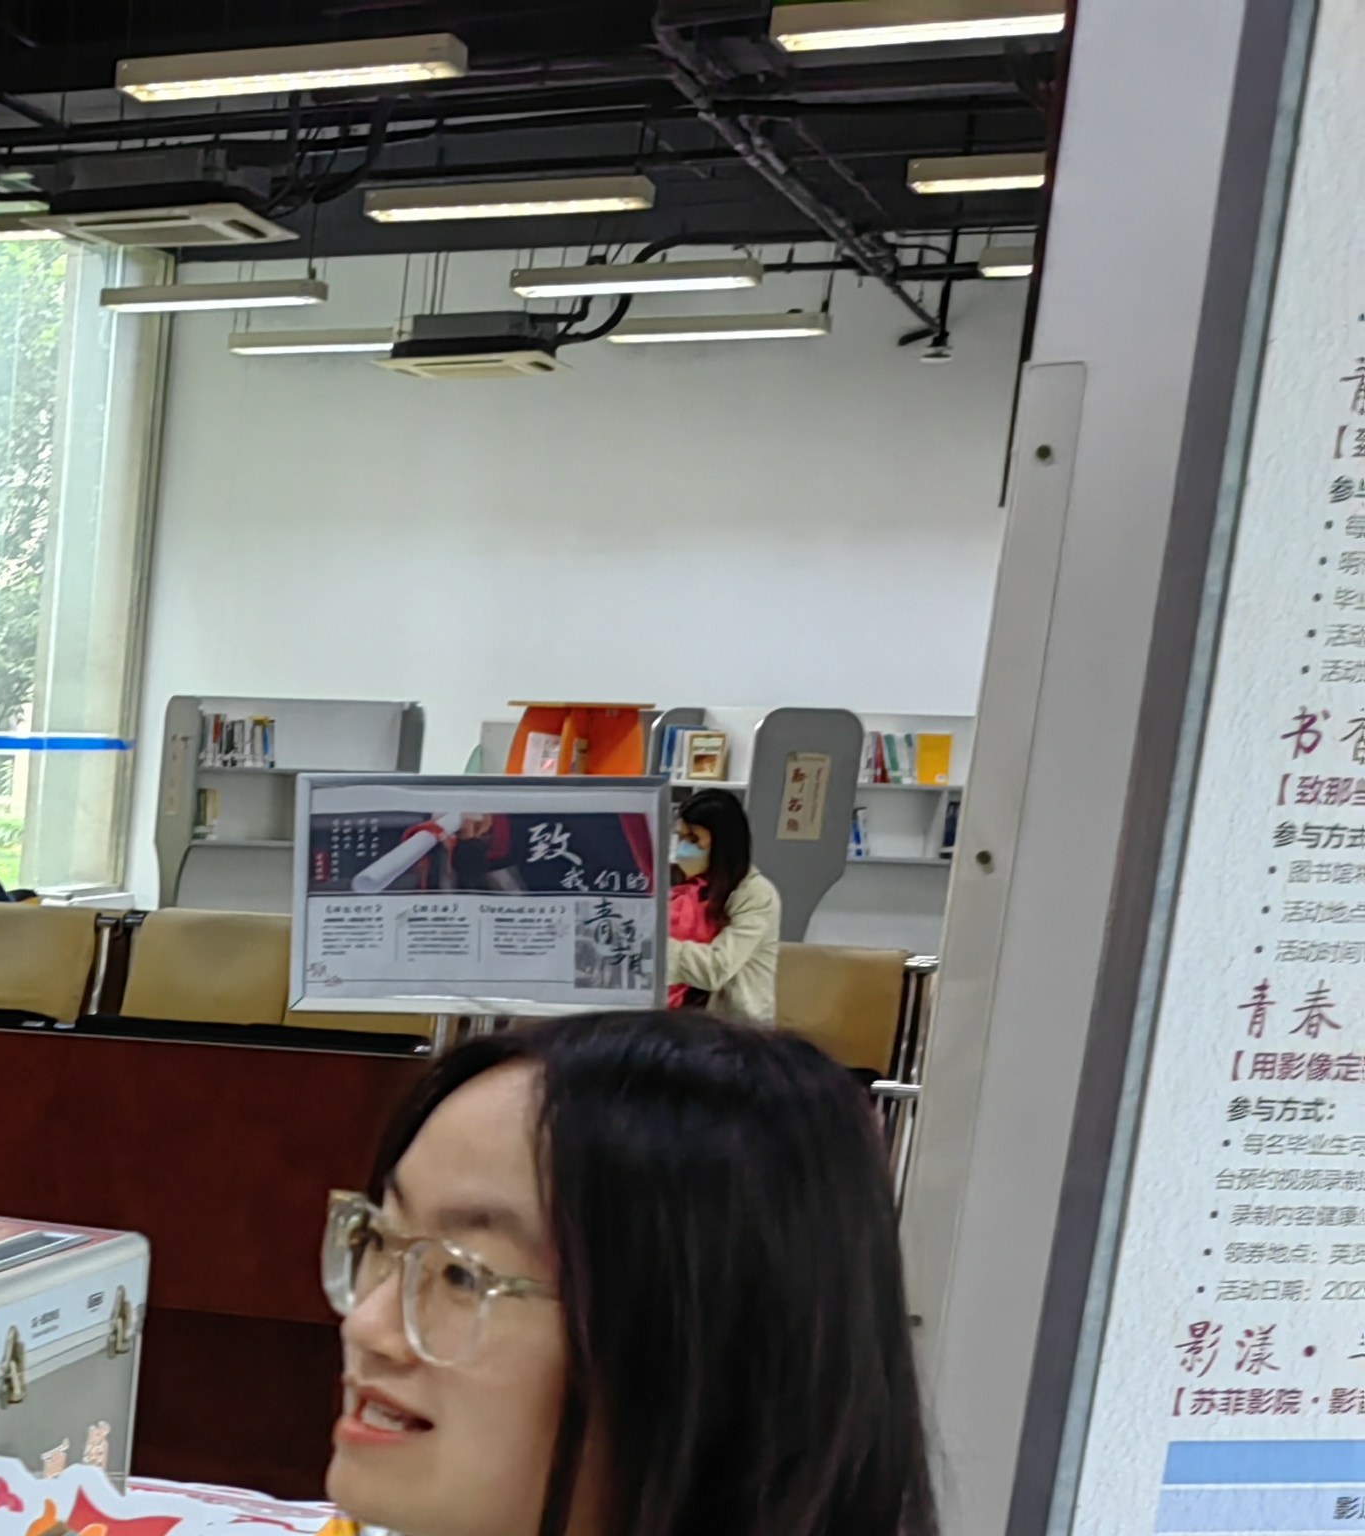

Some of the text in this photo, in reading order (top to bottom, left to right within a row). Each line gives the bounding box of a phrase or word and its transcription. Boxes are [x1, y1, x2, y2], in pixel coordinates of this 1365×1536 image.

[526, 822, 583, 866] 致
[560, 866, 650, 892] 我们的
[1237, 977, 1342, 1039] 青春
[1231, 1049, 1365, 1082] 【用影像定
[1332, 1496, 1365, 1520] 影
